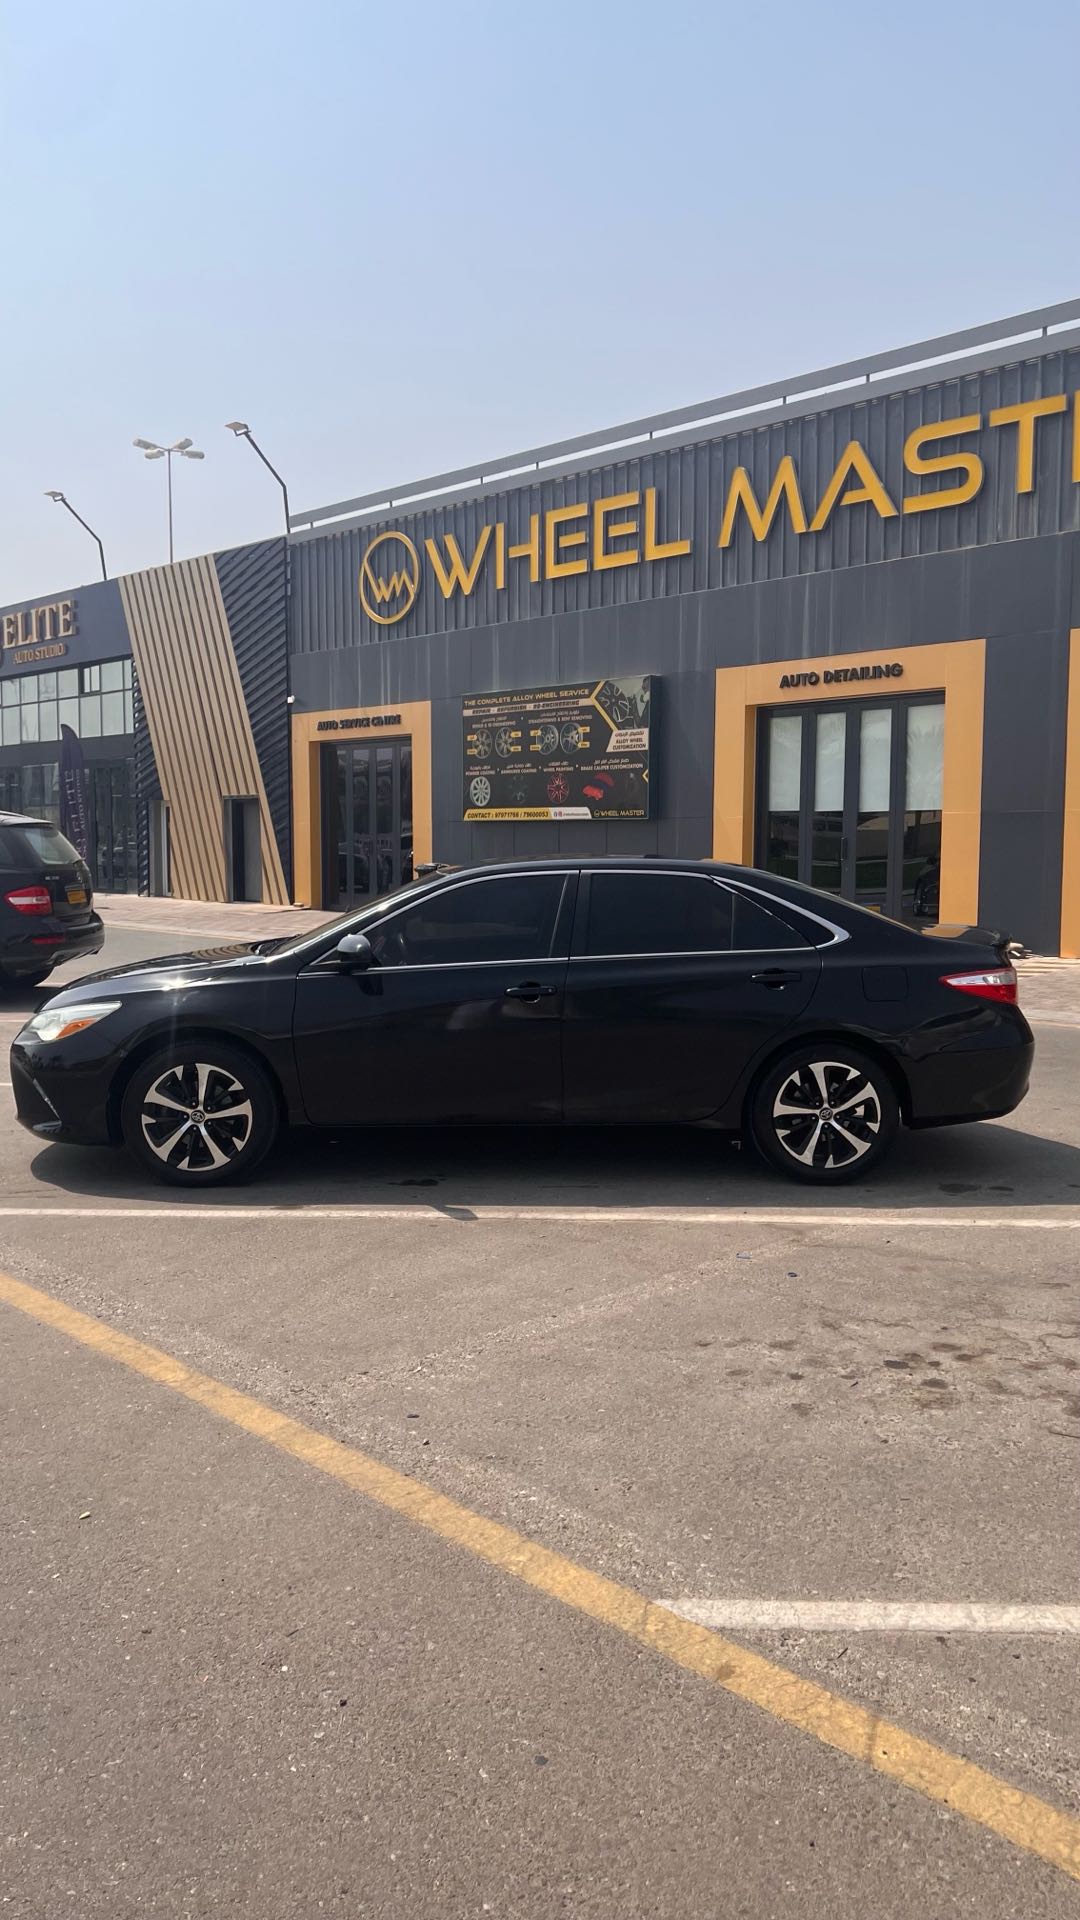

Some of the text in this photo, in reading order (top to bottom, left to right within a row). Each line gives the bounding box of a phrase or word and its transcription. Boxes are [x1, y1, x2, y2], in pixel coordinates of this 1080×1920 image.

[425, 390, 1080, 599] WHEEL MAST
[2, 600, 75, 649] ELITE
[13, 643, 65, 664] AUTO STUDIO
[779, 663, 903, 688] AUTO DETAILING
[477, 697, 511, 705] COMPLETE
[559, 689, 589, 697] SERVICE
[317, 720, 338, 731] AUTO
[339, 717, 370, 729] SERVICE
